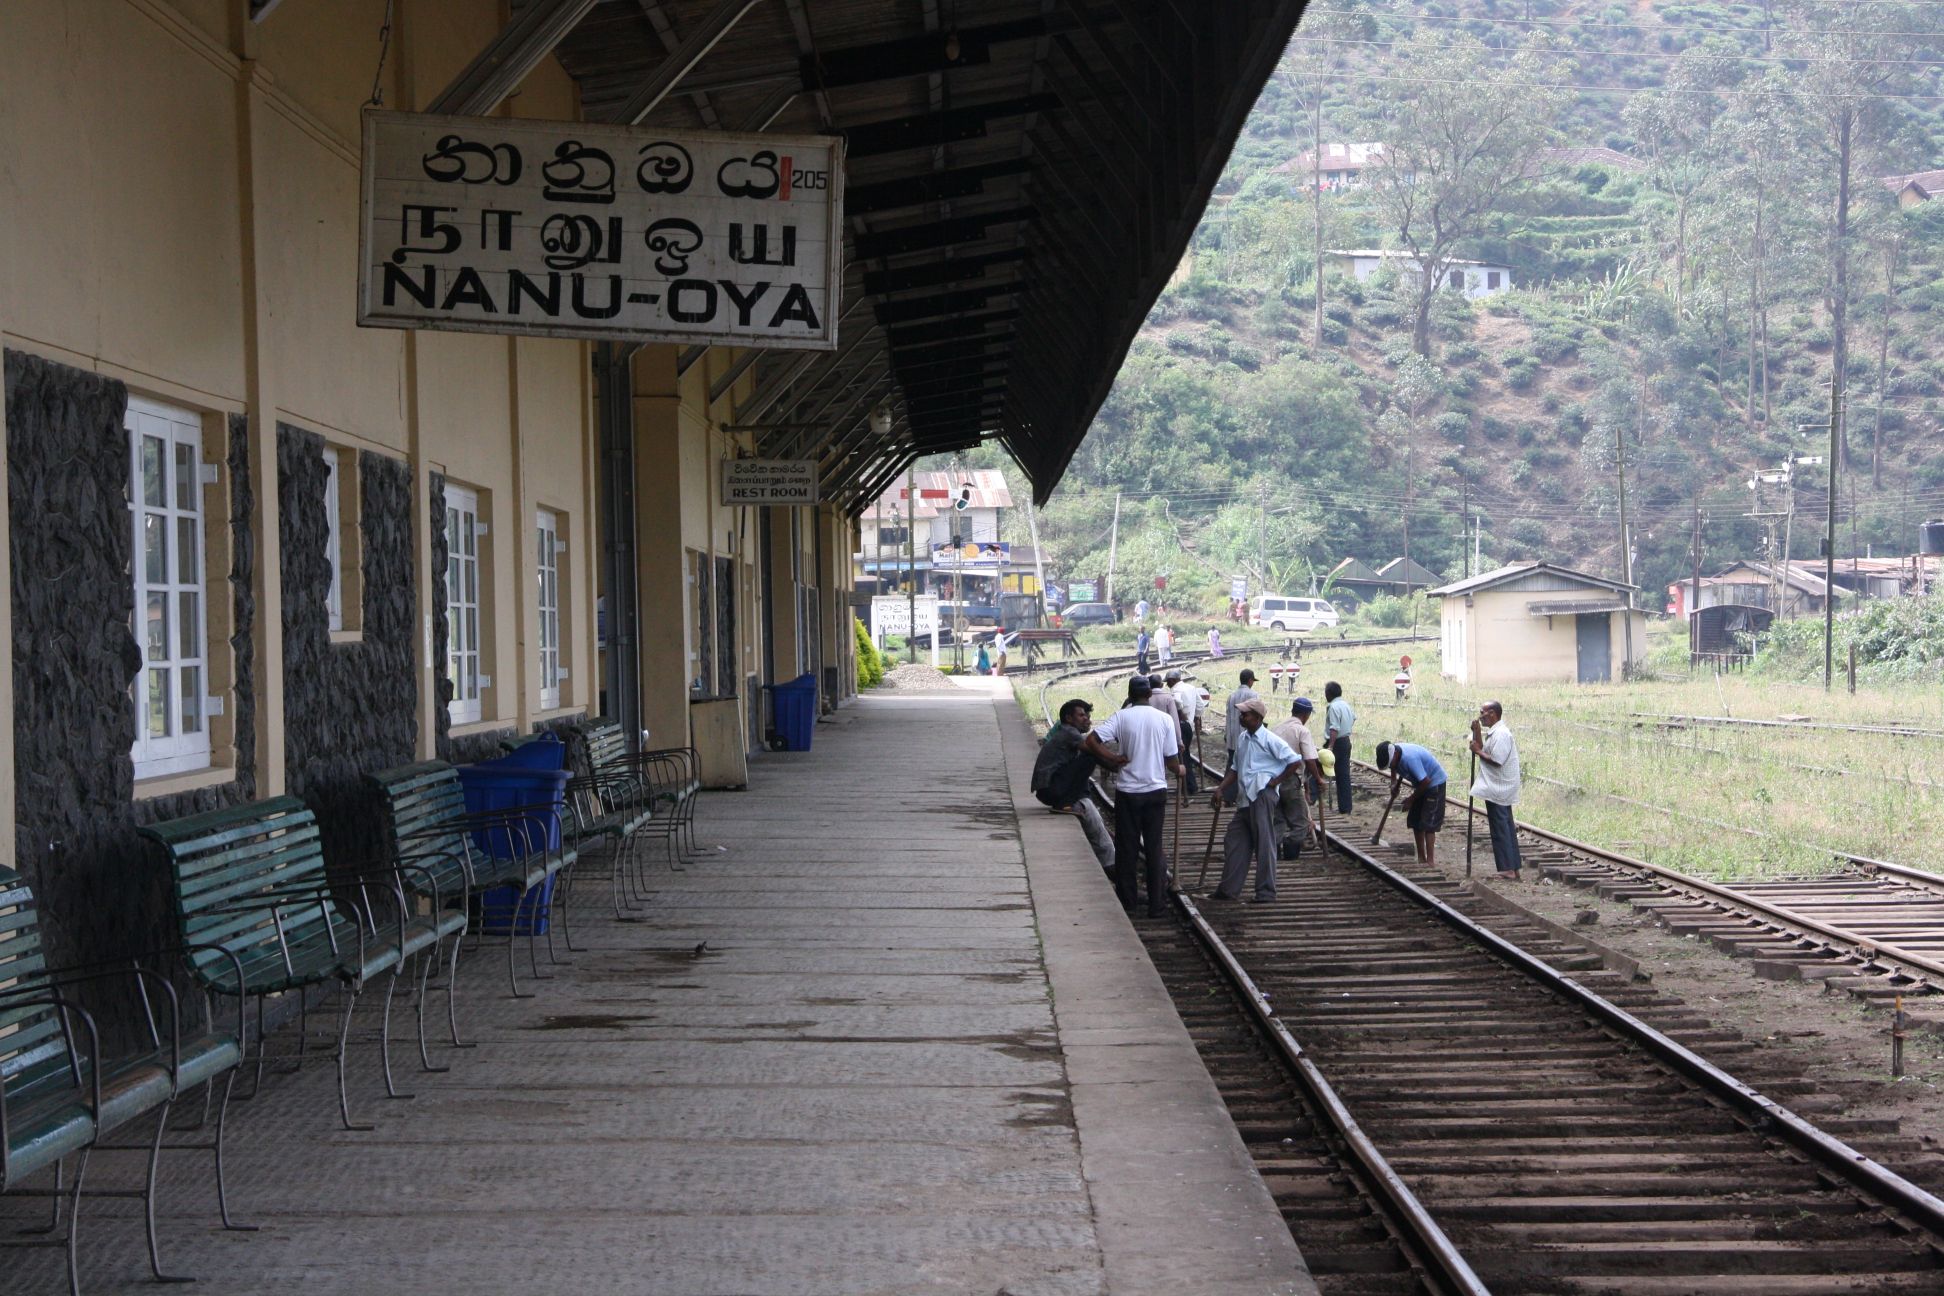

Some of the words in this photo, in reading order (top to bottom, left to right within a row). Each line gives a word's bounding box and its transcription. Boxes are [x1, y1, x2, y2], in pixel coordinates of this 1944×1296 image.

[792, 169, 828, 190] 205
[382, 262, 822, 329] NANU-OYA
[733, 487, 767, 498] REST
[770, 487, 808, 498] ROOM
